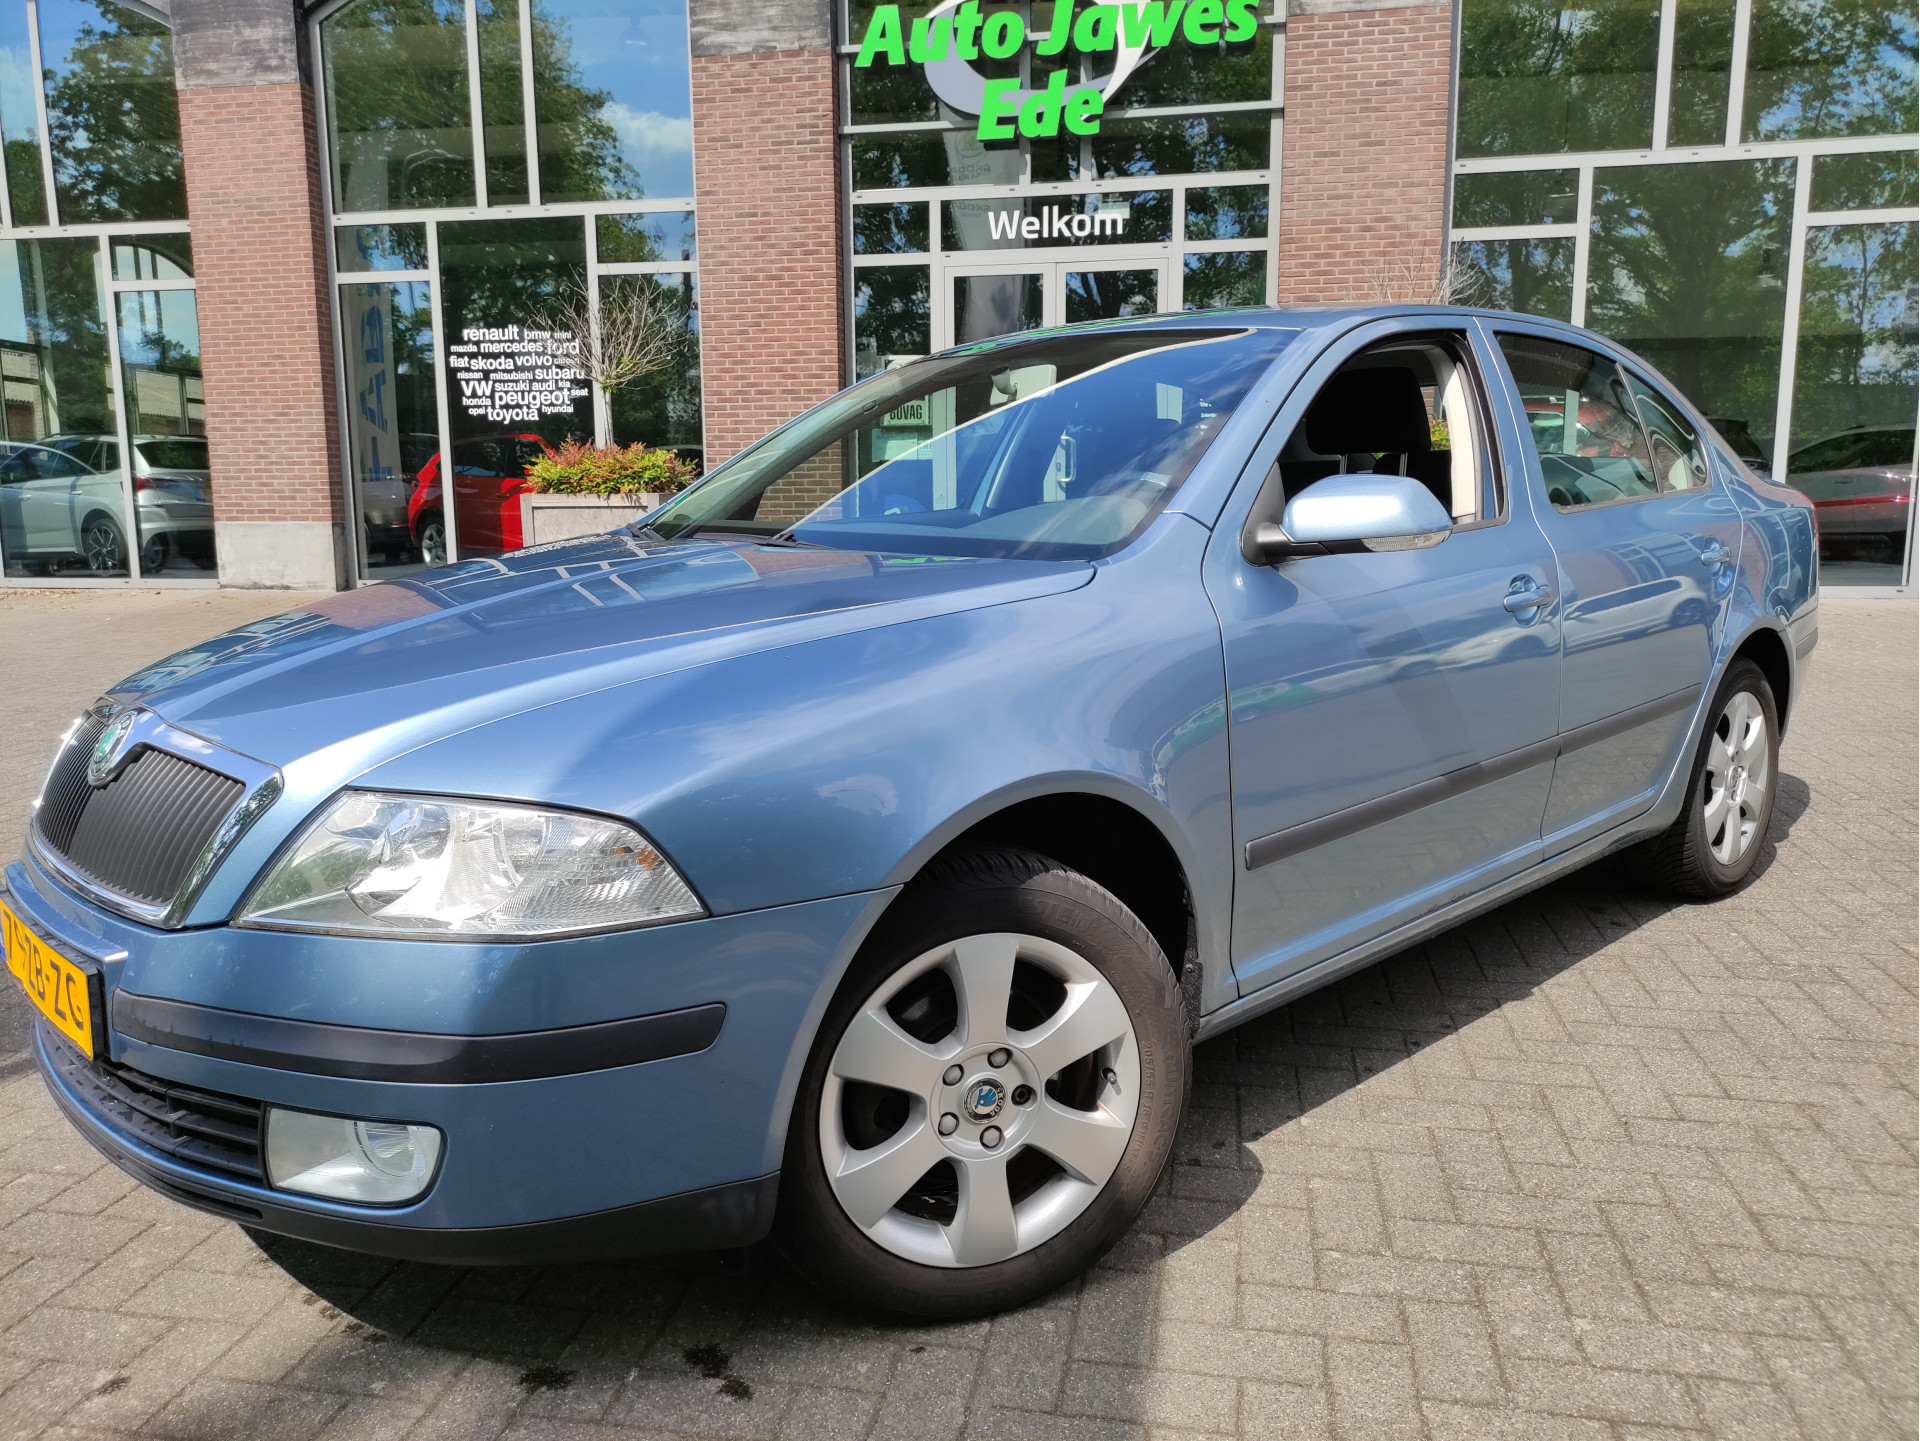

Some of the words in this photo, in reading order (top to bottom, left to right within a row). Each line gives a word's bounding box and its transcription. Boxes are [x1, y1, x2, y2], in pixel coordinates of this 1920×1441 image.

[854, 0, 1025, 67] Auto
[1036, 0, 1259, 56] Jawes
[976, 69, 1105, 141] Ede
[987, 205, 1124, 240] Welkom
[462, 324, 519, 341] renault
[524, 329, 551, 340] bmw
[554, 331, 572, 339] mini
[450, 343, 478, 353] mazda
[480, 339, 544, 353] mercedes
[544, 338, 580, 355] ford
[449, 355, 469, 368] fiat
[470, 356, 515, 370] skoda
[515, 352, 553, 366] volvo
[457, 371, 484, 379] nissan
[490, 370, 533, 380] mitsubishi
[534, 366, 585, 380] subaru
[494, 380, 530, 391] suzuki
[532, 379, 556, 391] audi
[558, 379, 571, 388] kia
[462, 396, 492, 406] honda
[494, 388, 571, 409] peugeot
[571, 387, 589, 396] seat
[468, 406, 486, 415] opel
[487, 405, 539, 425] toyota
[541, 404, 574, 415] hyundai
[889, 404, 923, 420] BOVAG
